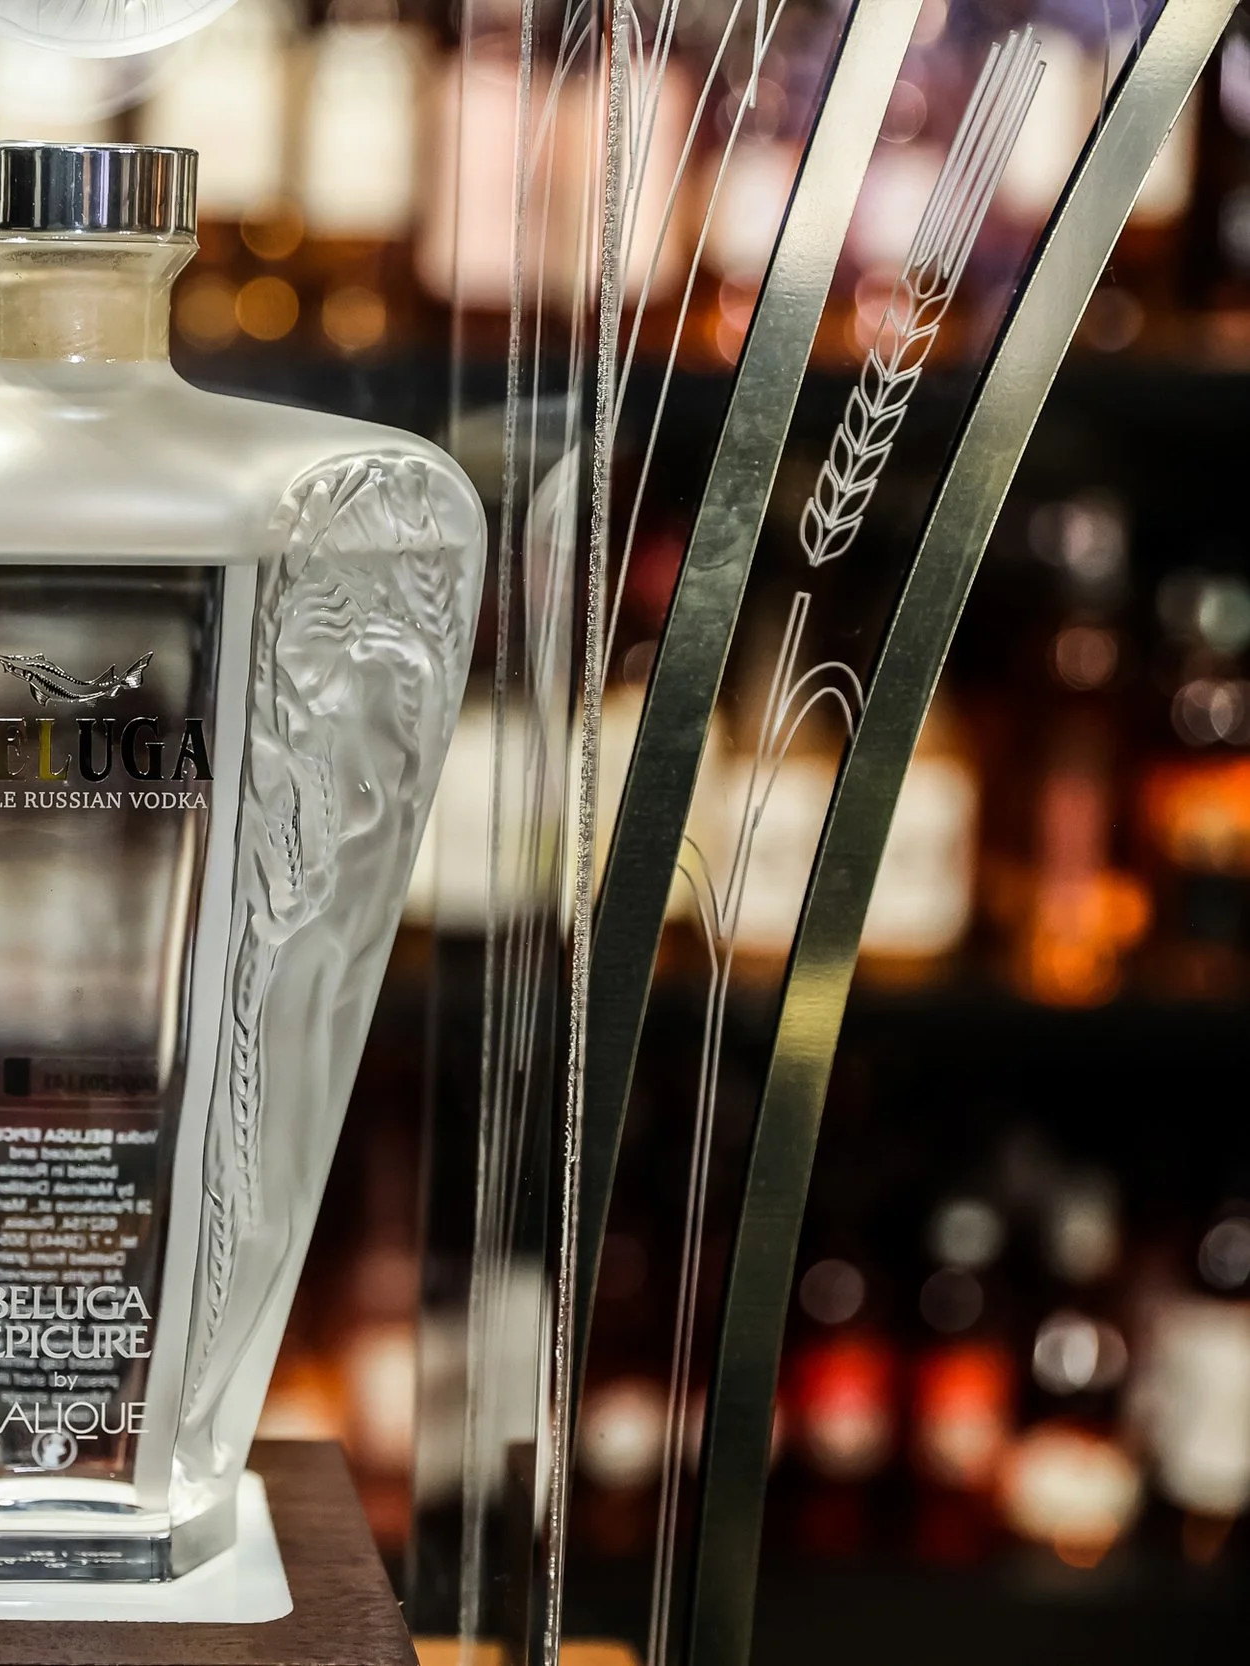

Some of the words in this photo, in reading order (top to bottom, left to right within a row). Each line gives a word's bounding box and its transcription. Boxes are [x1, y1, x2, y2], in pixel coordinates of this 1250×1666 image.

[24, 791, 122, 809] RUSSIAN
[129, 792, 208, 809] VODKA
[54, 1371, 78, 1391] by
